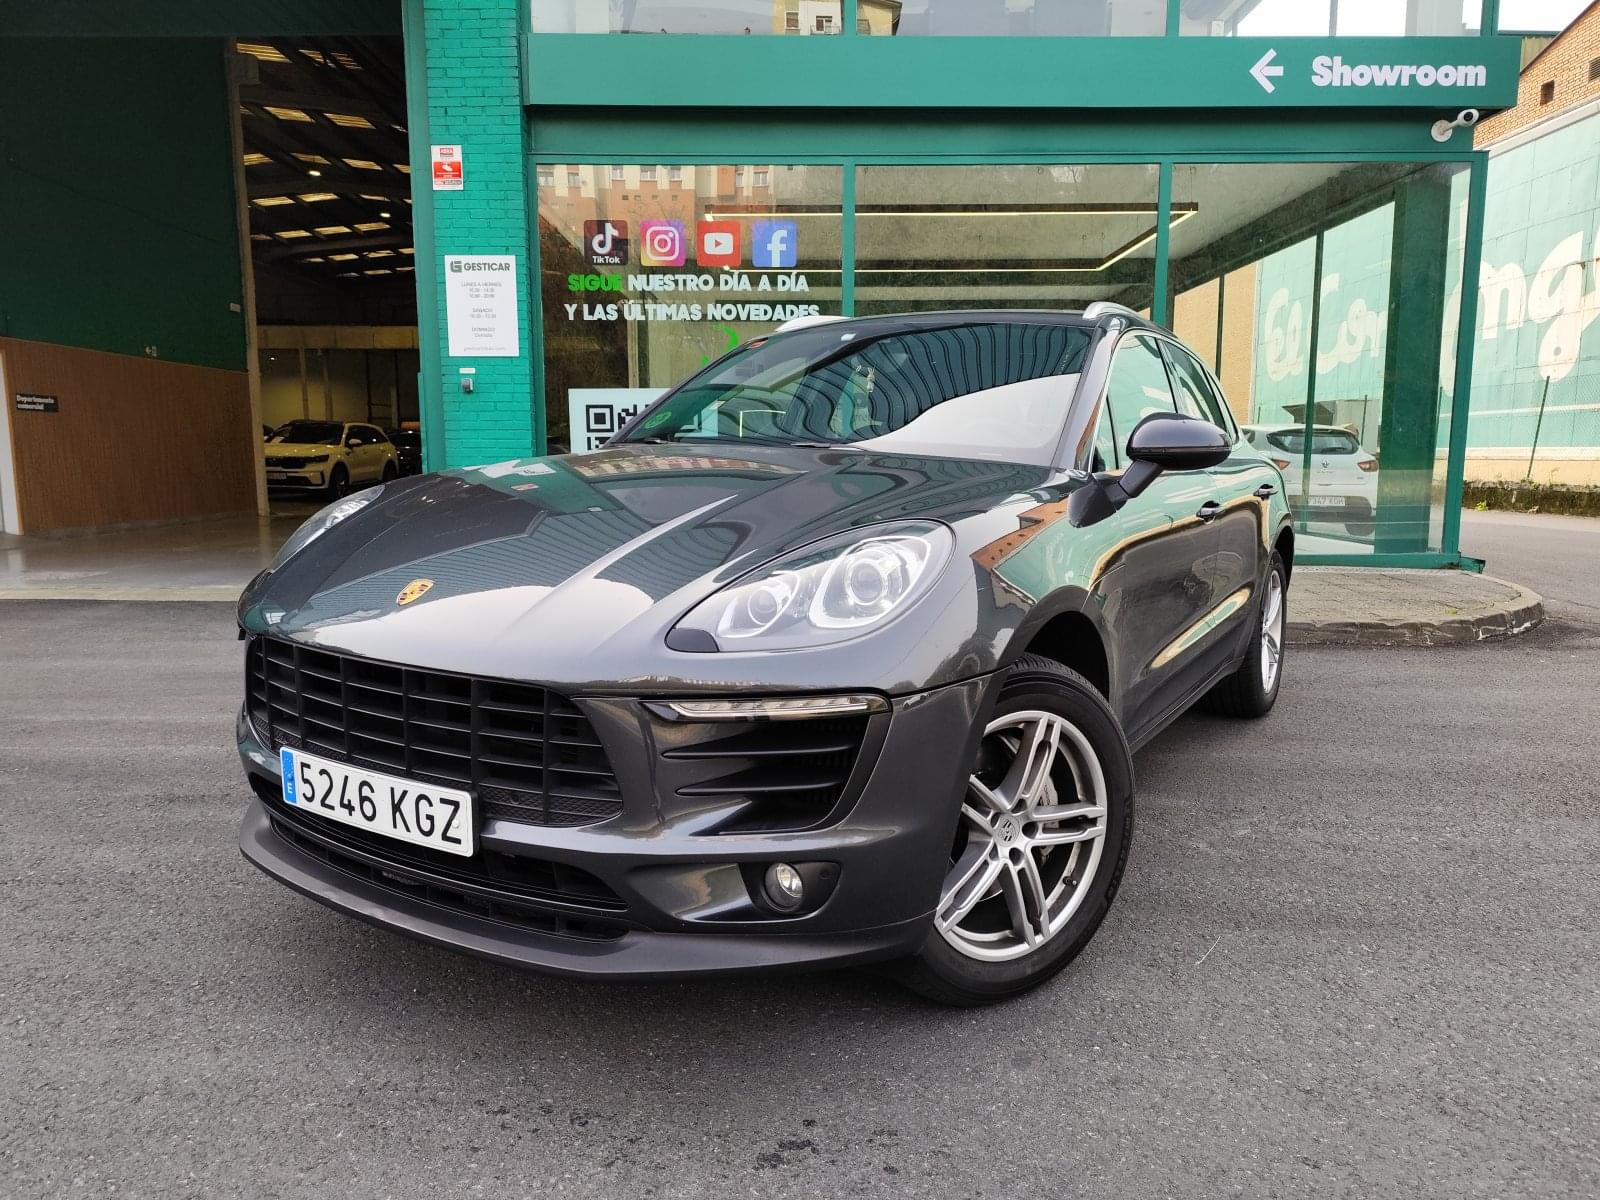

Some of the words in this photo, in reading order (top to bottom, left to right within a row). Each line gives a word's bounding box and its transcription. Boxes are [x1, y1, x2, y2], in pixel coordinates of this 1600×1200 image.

[1311, 55, 1487, 87] Showroom
[463, 262, 511, 272] GESTICAR
[592, 255, 621, 264] TikTok
[567, 273, 623, 293] SIGUE
[628, 274, 714, 292] NUESTRO
[719, 271, 752, 292] DÍA
[757, 276, 772, 292] A
[777, 271, 809, 292] DÍA
[564, 304, 578, 321] Y
[583, 303, 619, 321] LAS
[623, 299, 702, 321] ÚLTIMAS
[707, 304, 820, 322] NOVEDADES
[287, 783, 293, 794] E
[300, 761, 377, 822] 5246
[390, 786, 463, 846] KGZ
